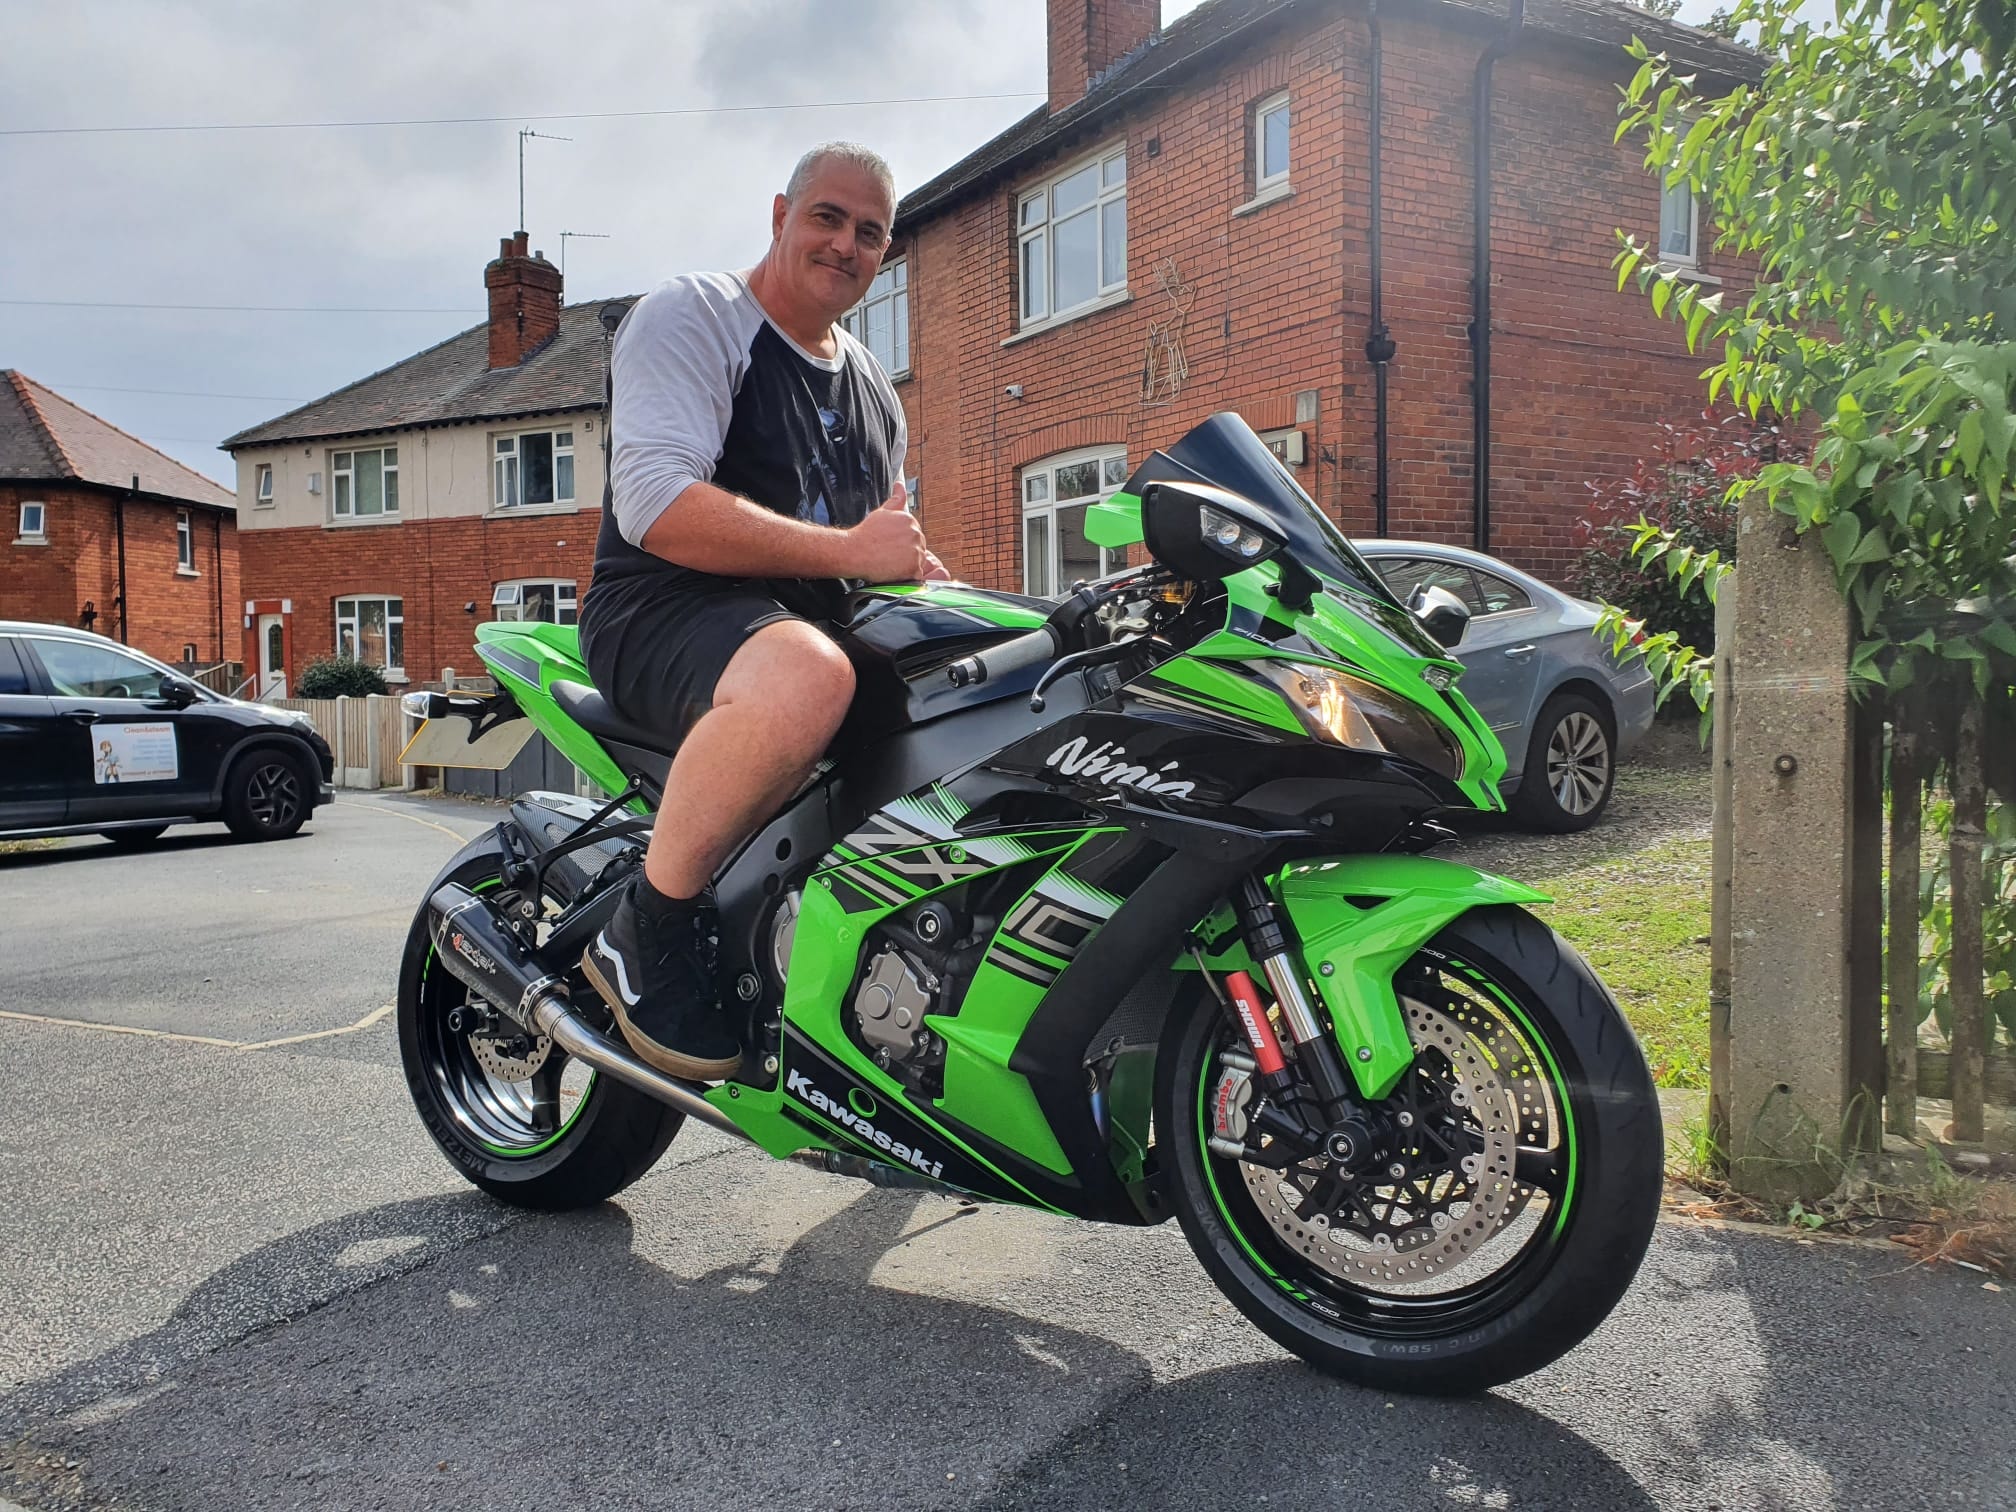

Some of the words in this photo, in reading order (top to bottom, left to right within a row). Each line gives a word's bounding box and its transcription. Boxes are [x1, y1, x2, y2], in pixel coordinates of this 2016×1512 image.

[1046, 736, 1195, 801] Ninja
[1235, 999, 1265, 1049] SHOWA
[786, 1068, 943, 1179] Kawasaki
[1218, 1078, 1233, 1131] brembo
[1311, 1301, 1340, 1318] 1000
